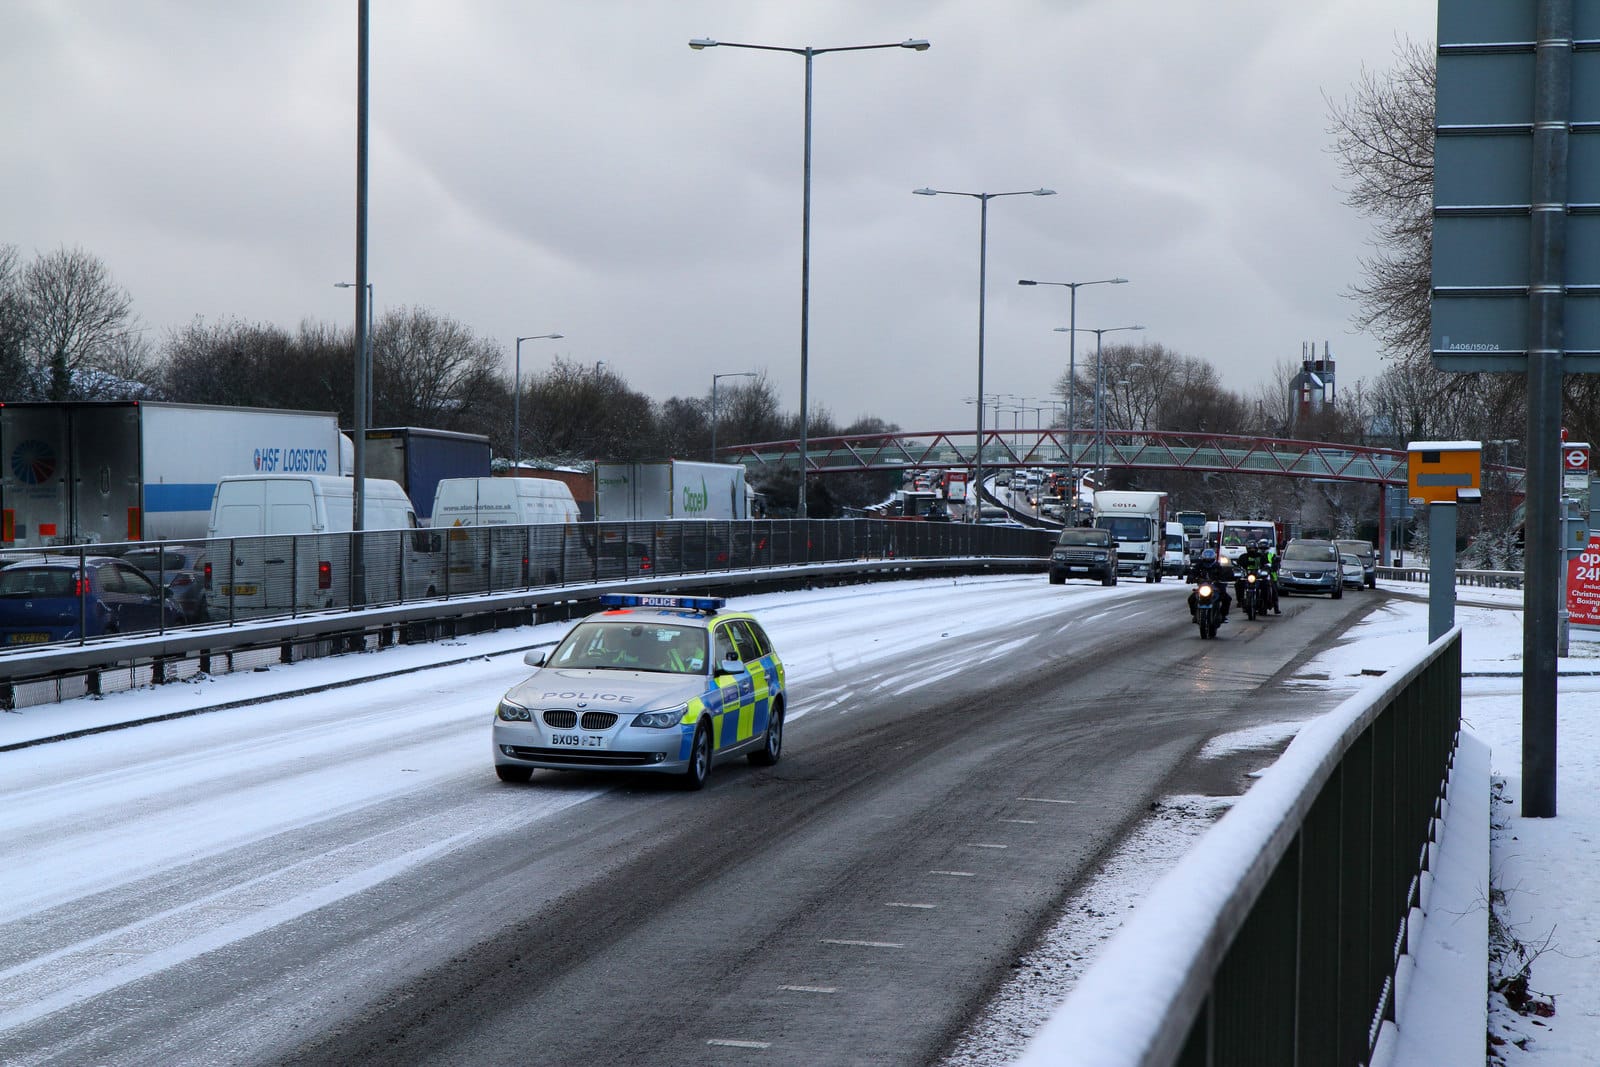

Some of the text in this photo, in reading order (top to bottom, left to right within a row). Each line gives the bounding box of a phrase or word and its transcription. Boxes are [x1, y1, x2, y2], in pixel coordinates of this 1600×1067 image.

[261, 447, 328, 472] HSF LOGISTICS
[642, 597, 676, 606] POLICE
[1568, 611, 1585, 619] New
[541, 692, 635, 703] POLICE
[552, 734, 579, 746] BX09
